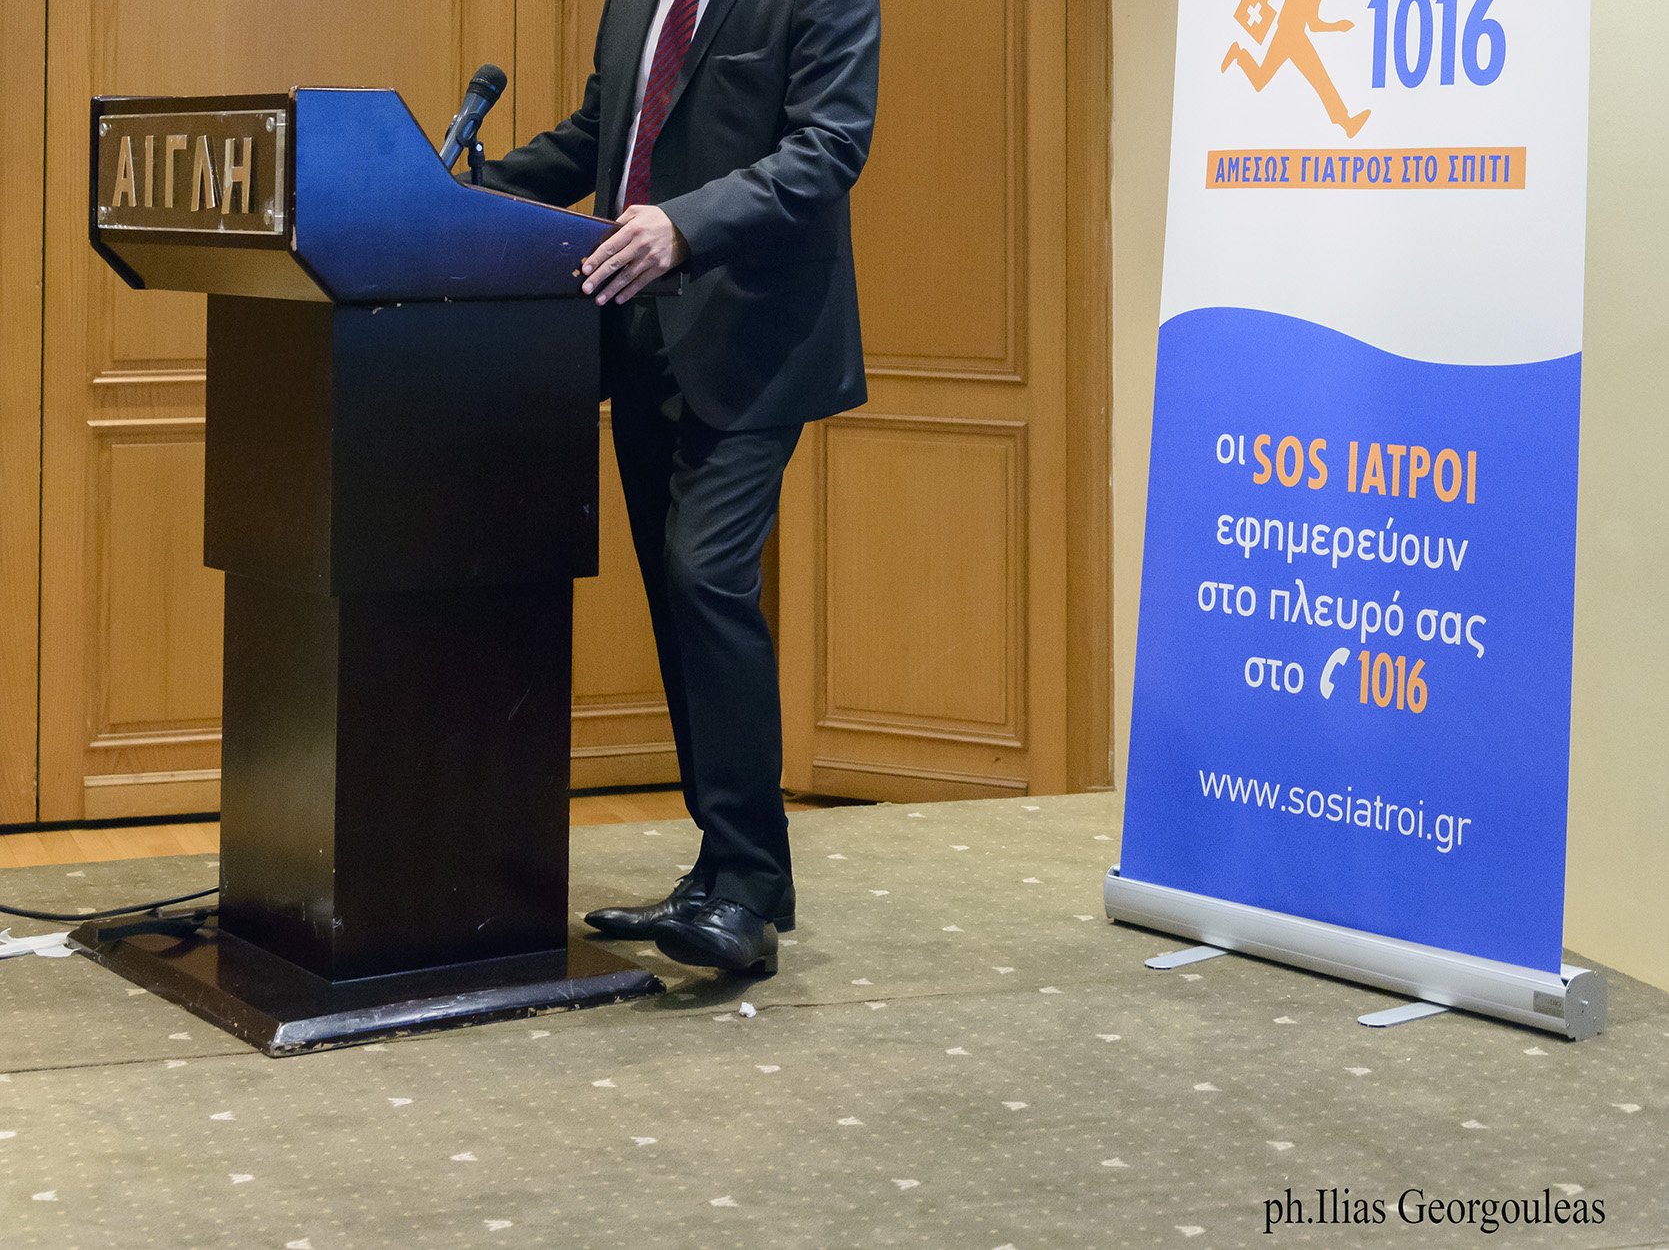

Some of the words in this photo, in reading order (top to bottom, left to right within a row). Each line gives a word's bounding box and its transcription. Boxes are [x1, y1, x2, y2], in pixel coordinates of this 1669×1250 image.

[112, 134, 252, 214] ΑΙΓΛΗ
[1215, 156, 1290, 183] ΑΜΕΣΩΣ
[1301, 156, 1392, 183] ΓΙΑΤΡΟΣ
[1402, 156, 1438, 183] ΣΤΟ
[1447, 155, 1511, 183] ΣΠΙΤΙ
[1216, 434, 1245, 466] οι
[1253, 434, 1327, 489] SOS
[1348, 441, 1477, 504] ΙΑΤΡΟΙ
[1216, 513, 1468, 571] εφημερεύουν
[1197, 581, 1256, 618] στο
[1270, 579, 1404, 643] πλευρό
[1416, 607, 1486, 657] σας
[1244, 656, 1303, 694] στο
[1358, 650, 1428, 714] 1016
[1199, 769, 1471, 853] www.sosiatroi.gr
